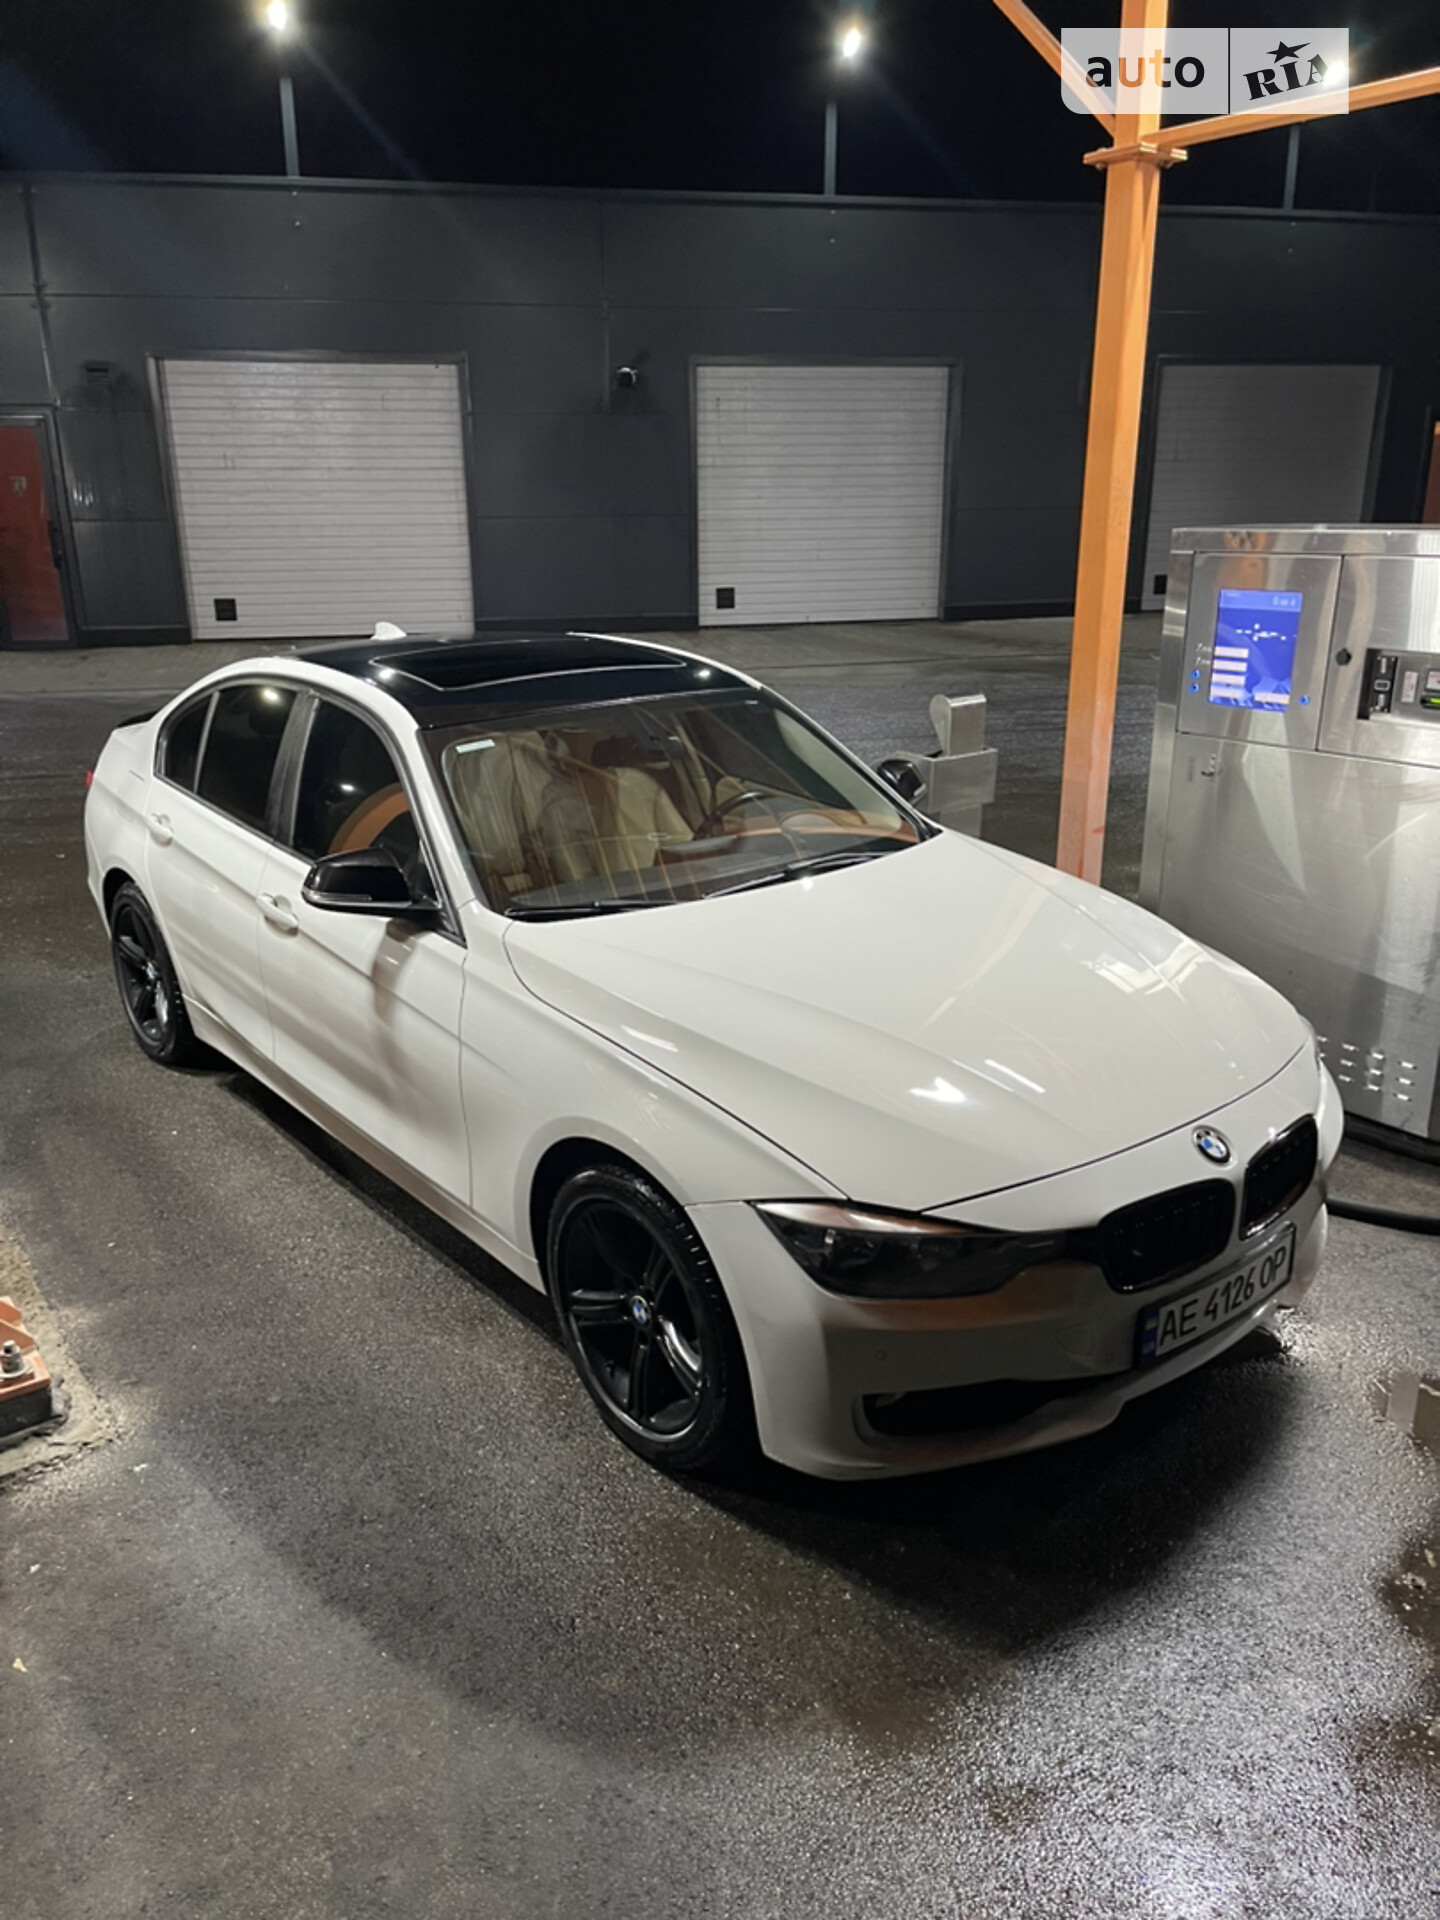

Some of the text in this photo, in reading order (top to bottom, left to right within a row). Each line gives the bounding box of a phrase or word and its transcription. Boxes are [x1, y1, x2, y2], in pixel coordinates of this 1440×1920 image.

[1160, 1245, 1287, 1346] AE 4126 OP
